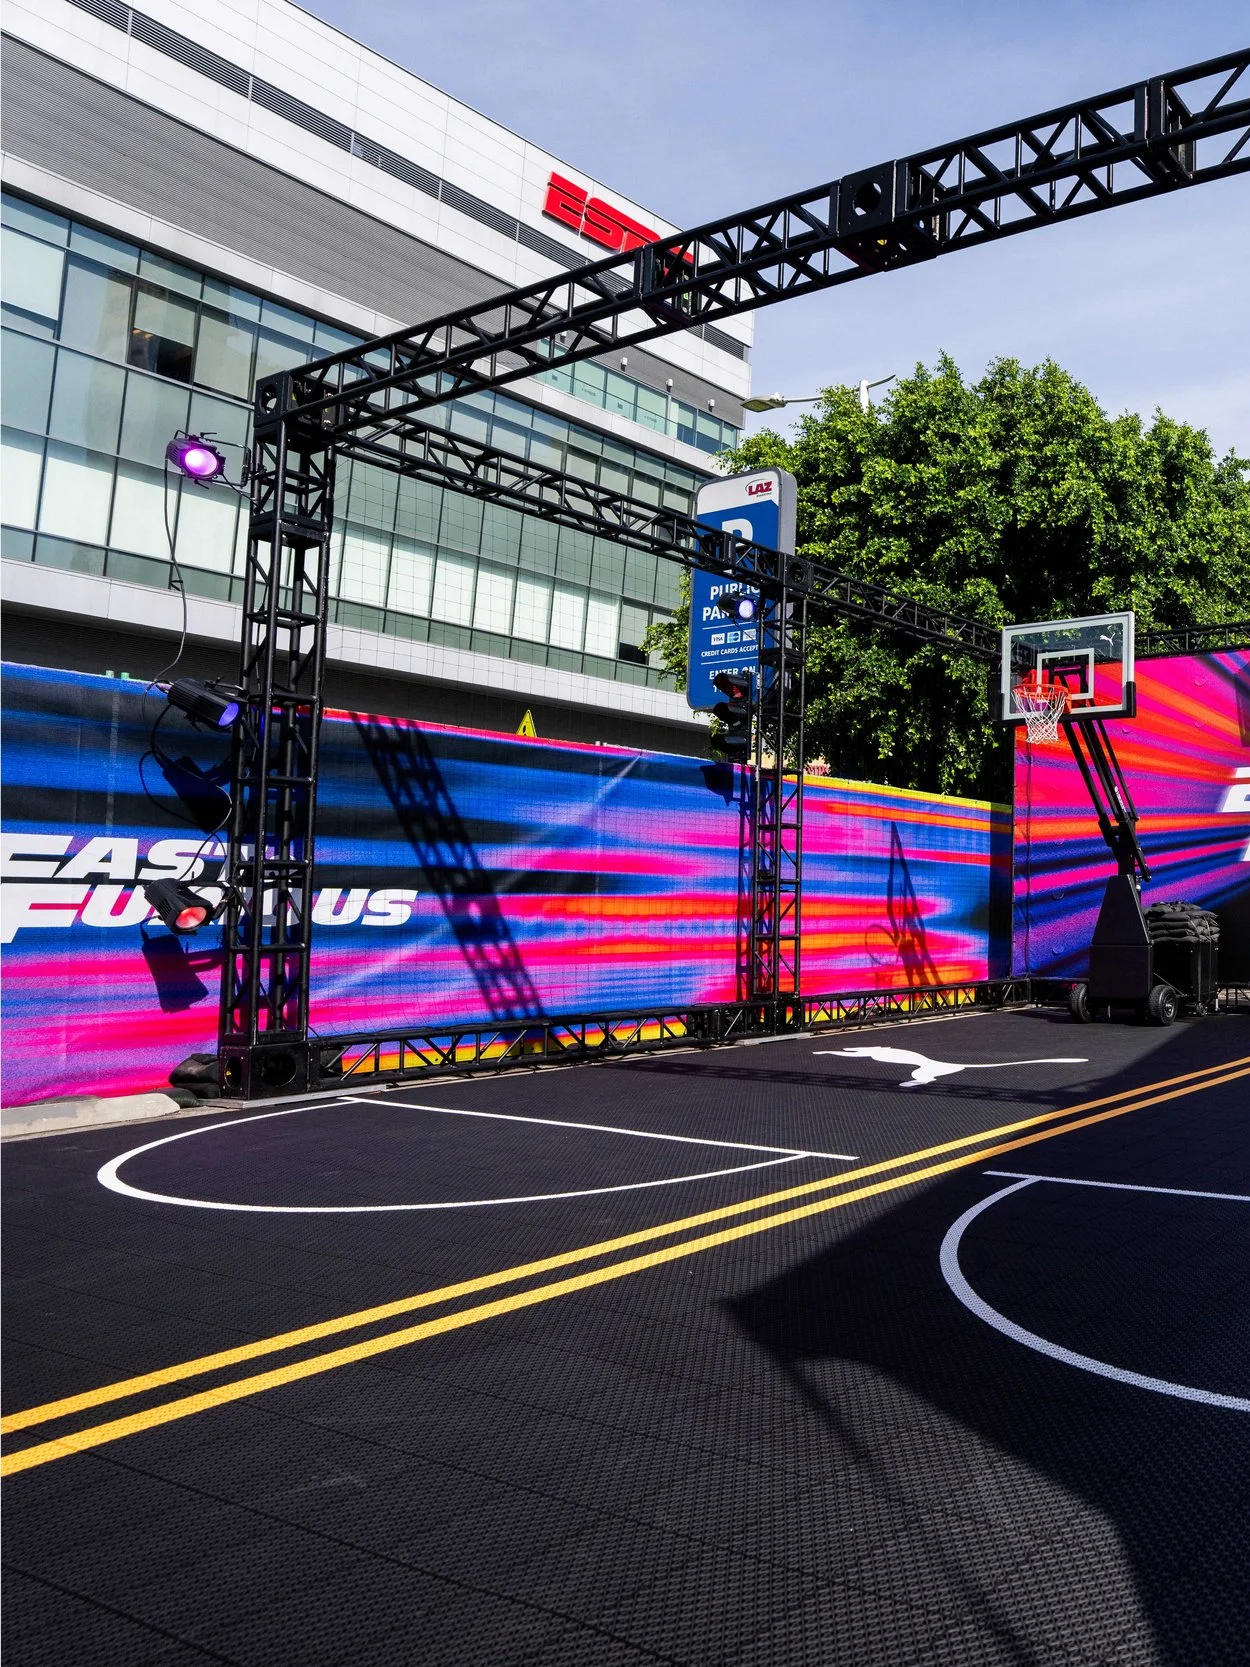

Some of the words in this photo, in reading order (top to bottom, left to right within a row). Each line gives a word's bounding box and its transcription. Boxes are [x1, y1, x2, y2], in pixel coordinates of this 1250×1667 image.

[748, 481, 772, 496] LAZ
[701, 649, 719, 657] CREDIT
[720, 647, 738, 655] CARDS
[740, 644, 765, 653] ACCEPT
